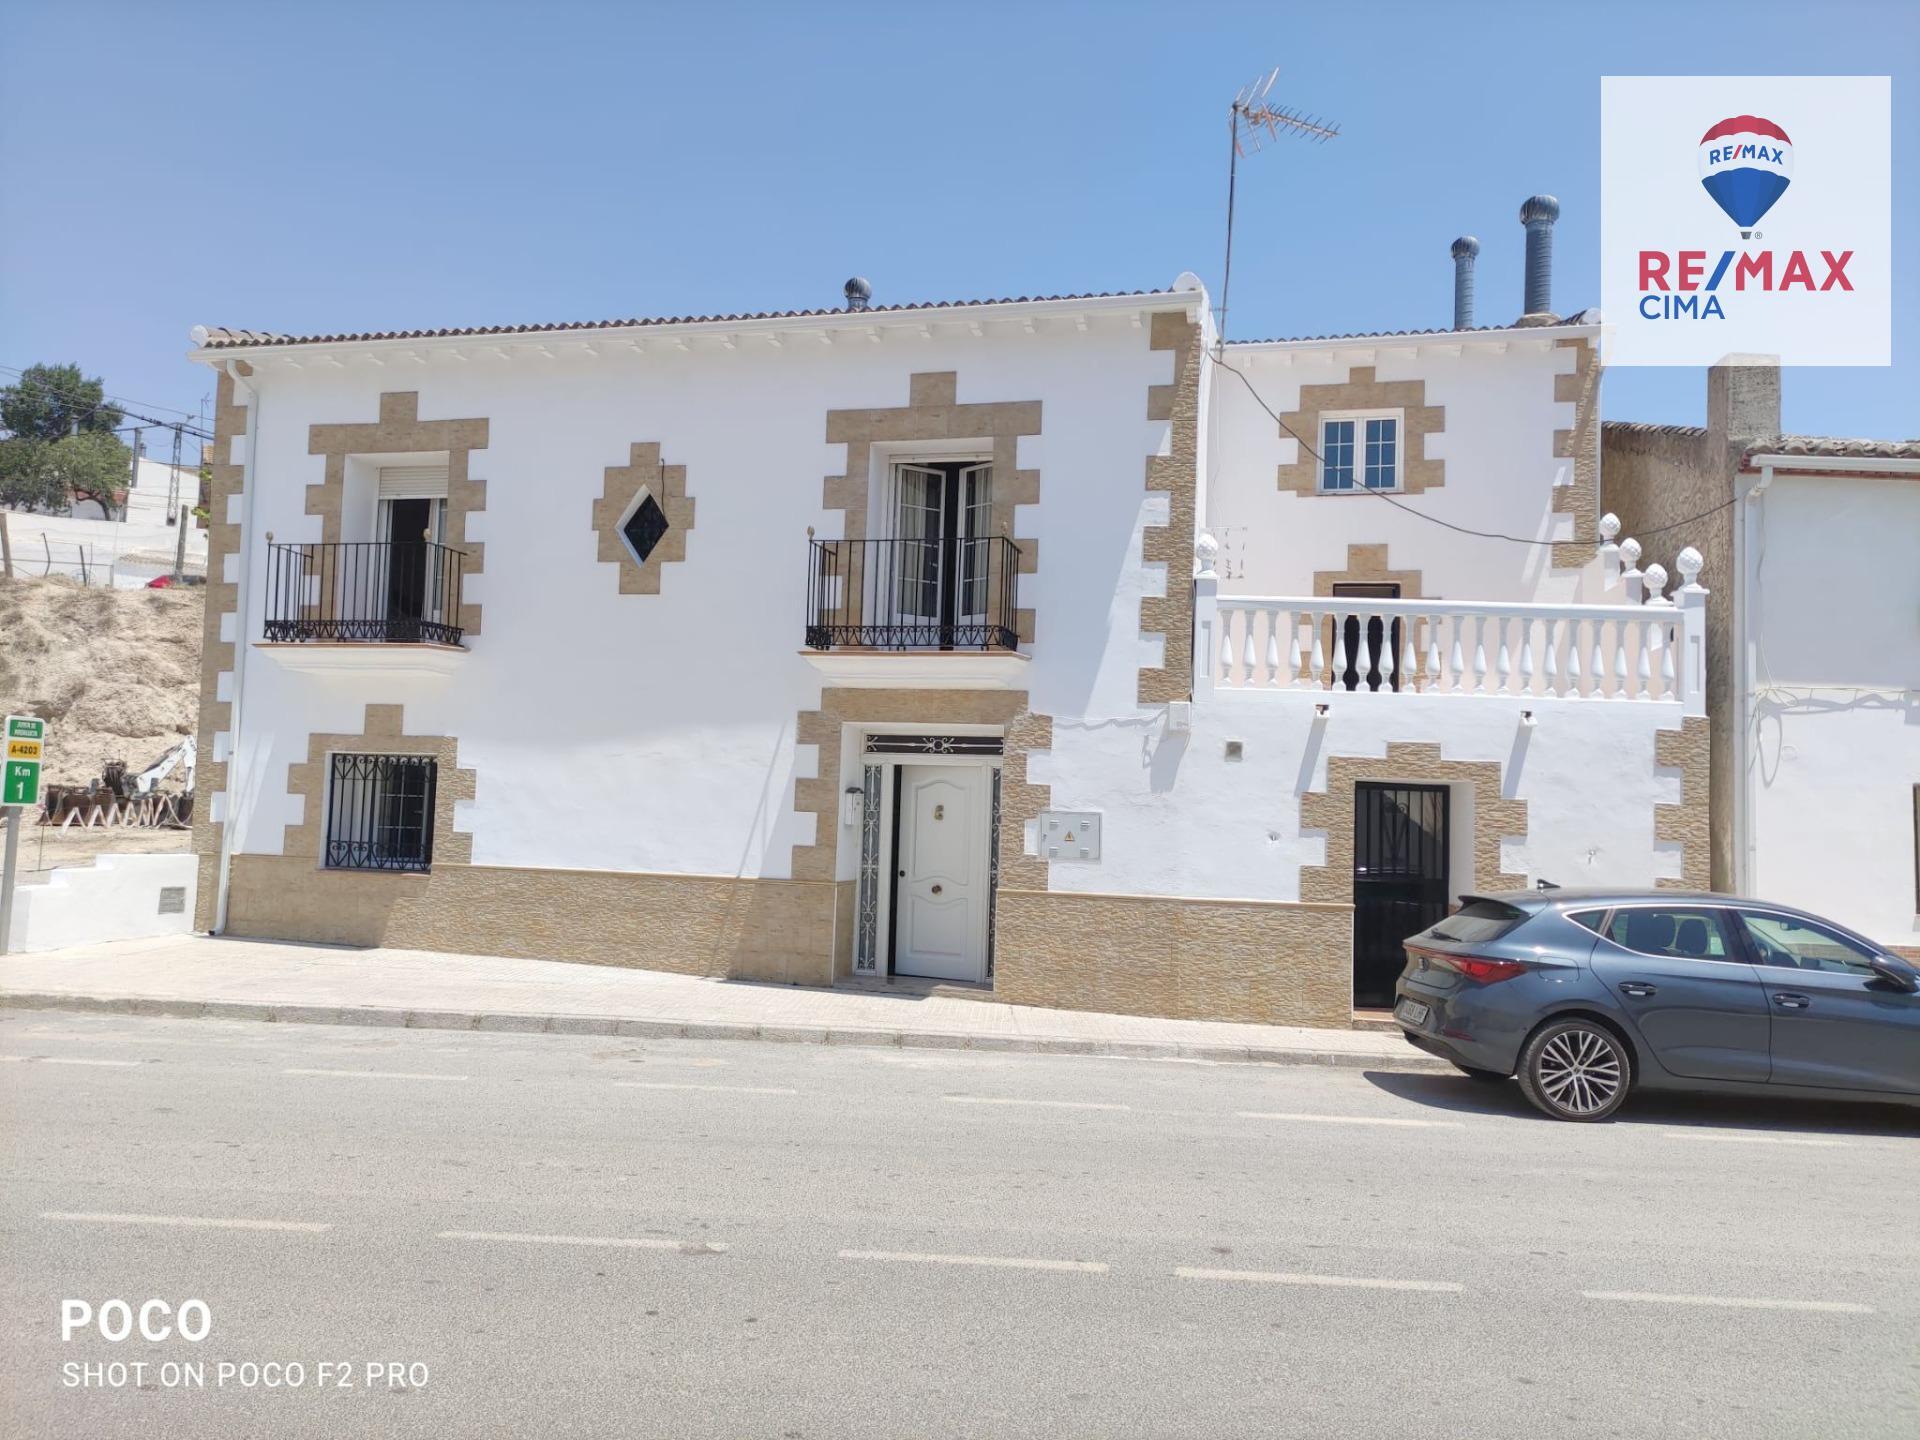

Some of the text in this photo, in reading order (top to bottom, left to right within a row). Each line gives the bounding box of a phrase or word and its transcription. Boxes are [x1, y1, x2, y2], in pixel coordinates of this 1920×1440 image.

[11, 745, 38, 755] A-4203
[15, 766, 31, 777] Km
[16, 782, 24, 800] 1
